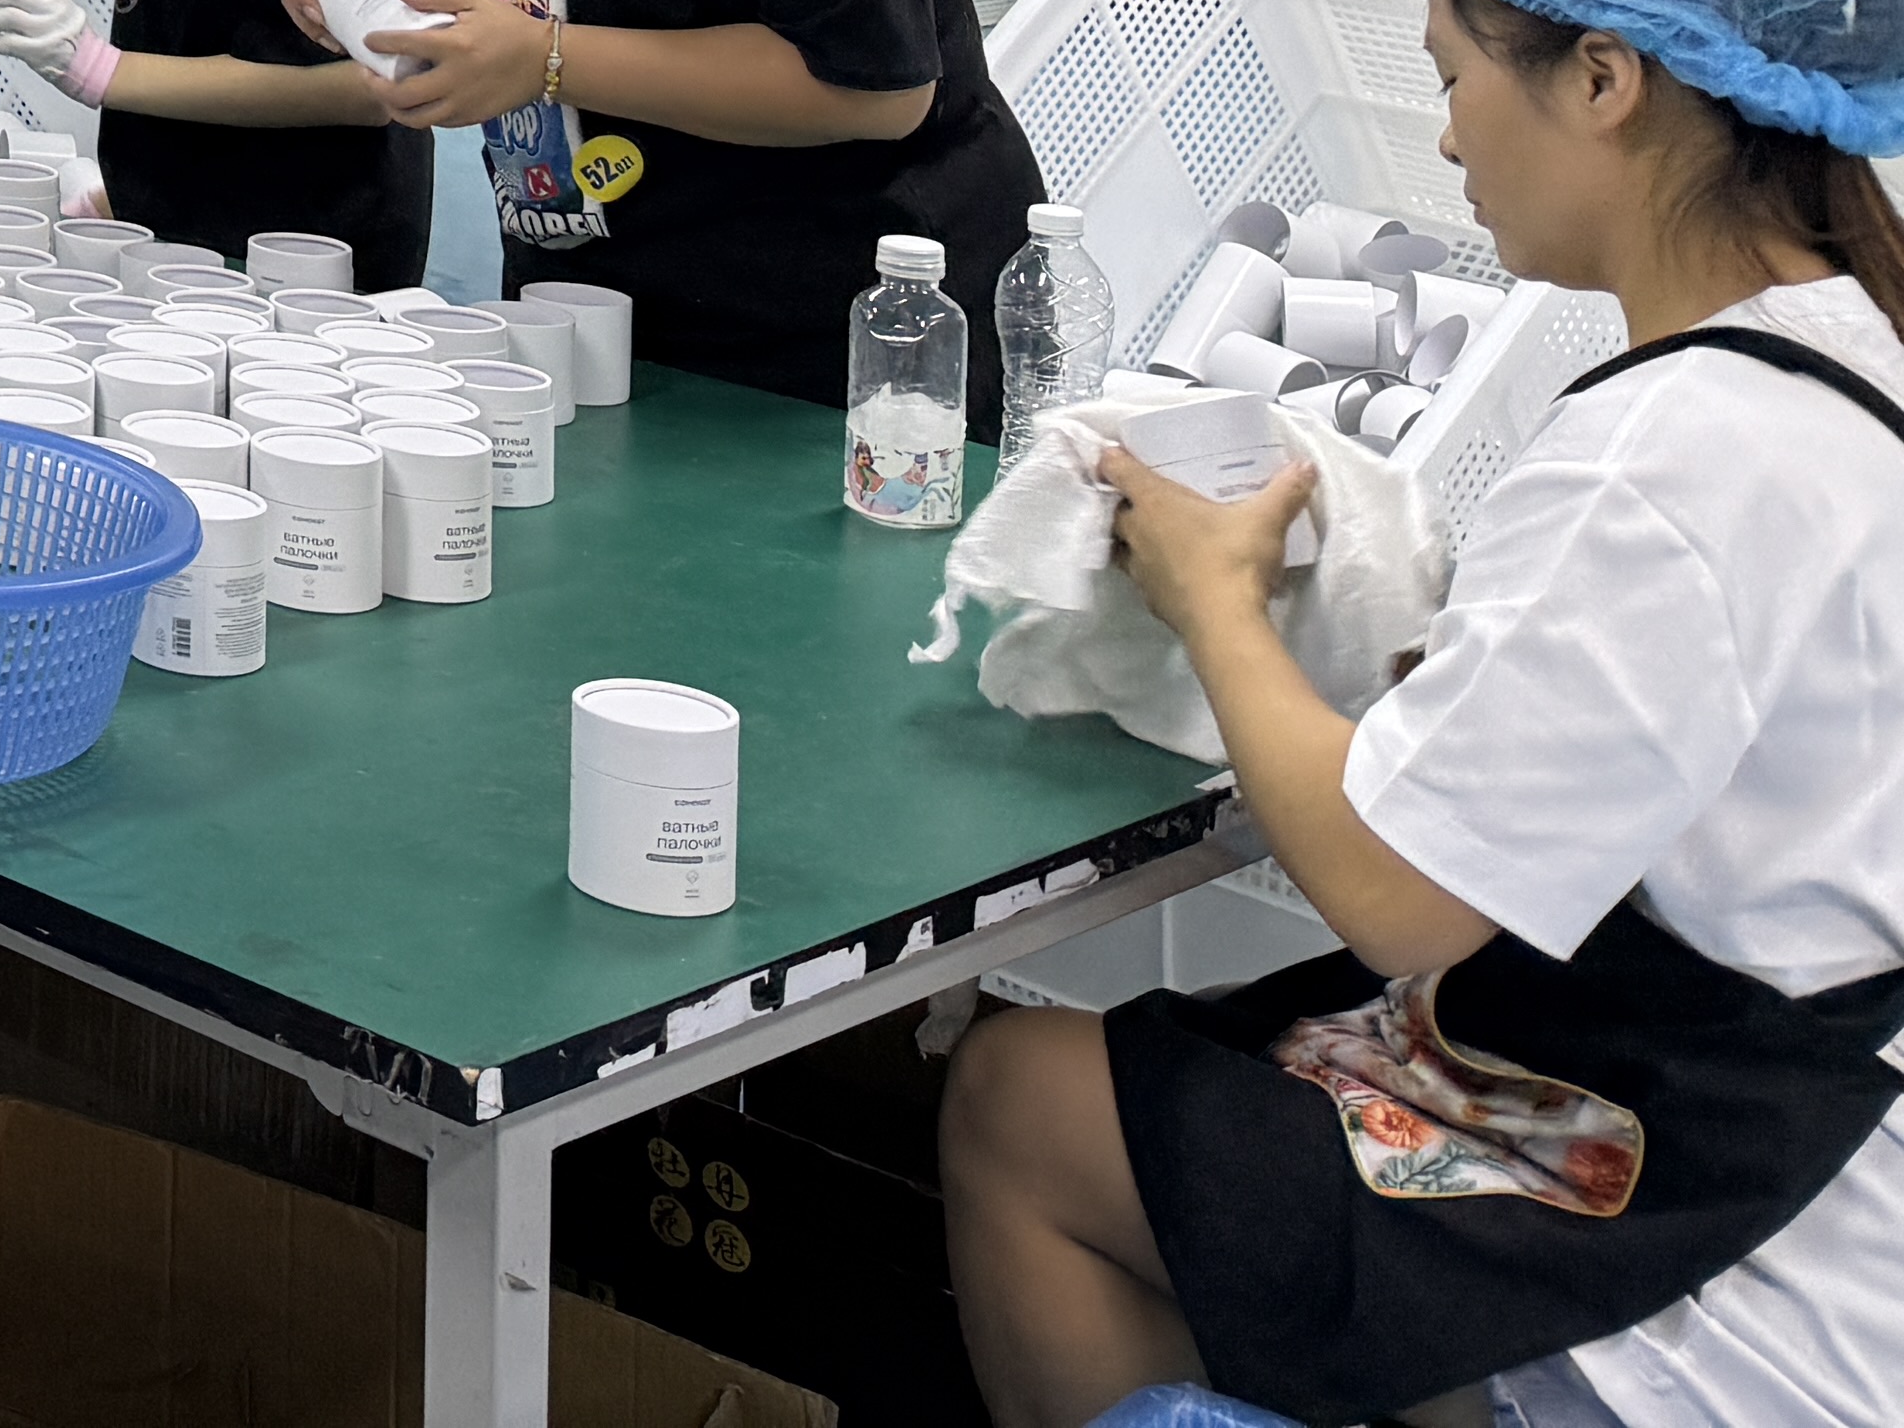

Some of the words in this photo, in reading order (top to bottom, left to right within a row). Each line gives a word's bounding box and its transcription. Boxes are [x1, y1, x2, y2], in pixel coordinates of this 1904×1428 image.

[283, 531, 335, 548] ватные
[280, 545, 339, 561] палочки
[661, 820, 719, 834] ватные
[657, 835, 722, 850] палочки
